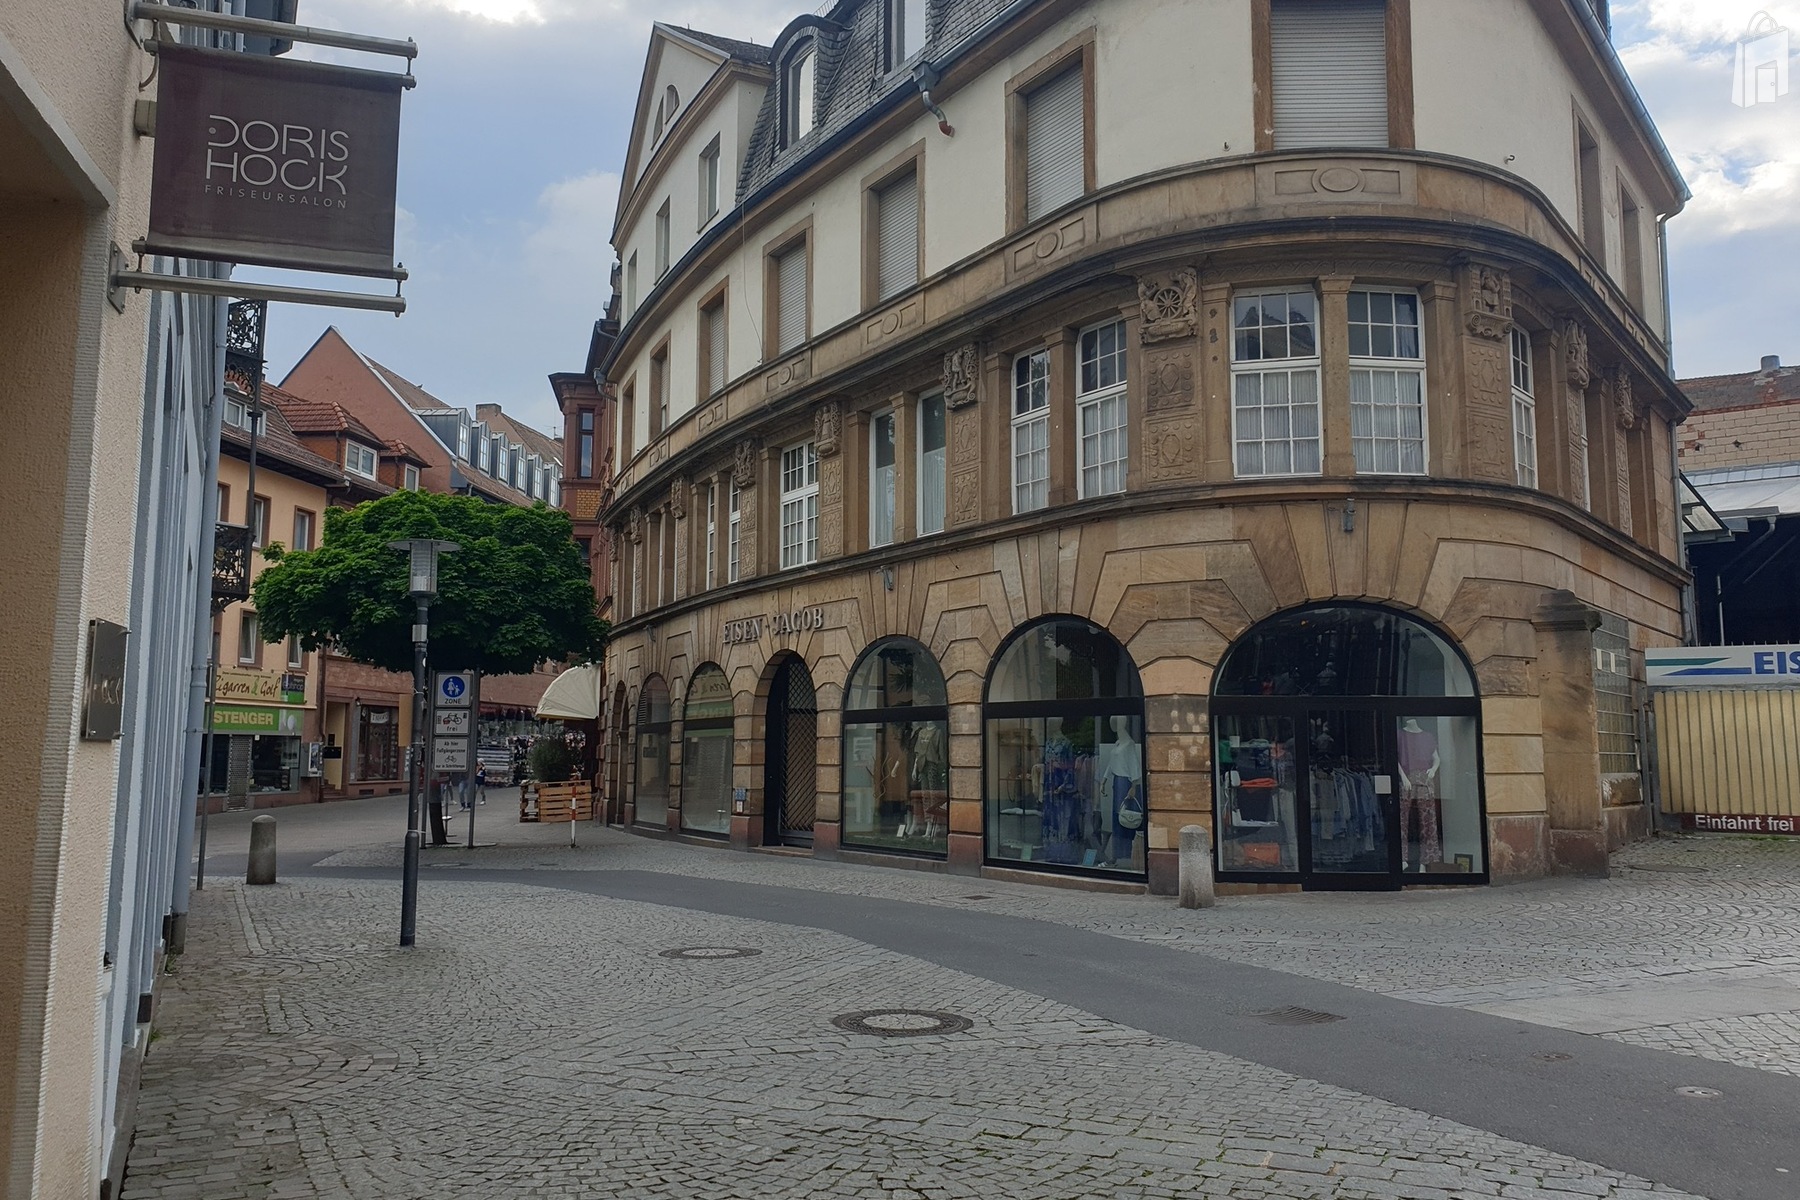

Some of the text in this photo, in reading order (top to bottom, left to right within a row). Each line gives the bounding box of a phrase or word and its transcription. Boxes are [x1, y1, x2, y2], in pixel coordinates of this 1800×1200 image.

[208, 114, 349, 161] DORIS
[206, 149, 347, 195] HOCK
[205, 184, 346, 209] FRISEURSALON
[723, 608, 823, 643] EISEN JACOB
[1754, 651, 1800, 674] EIS
[260, 677, 281, 697] Golf
[213, 710, 274, 726] STENGER
[1695, 814, 1794, 832] Einfahrt frei
